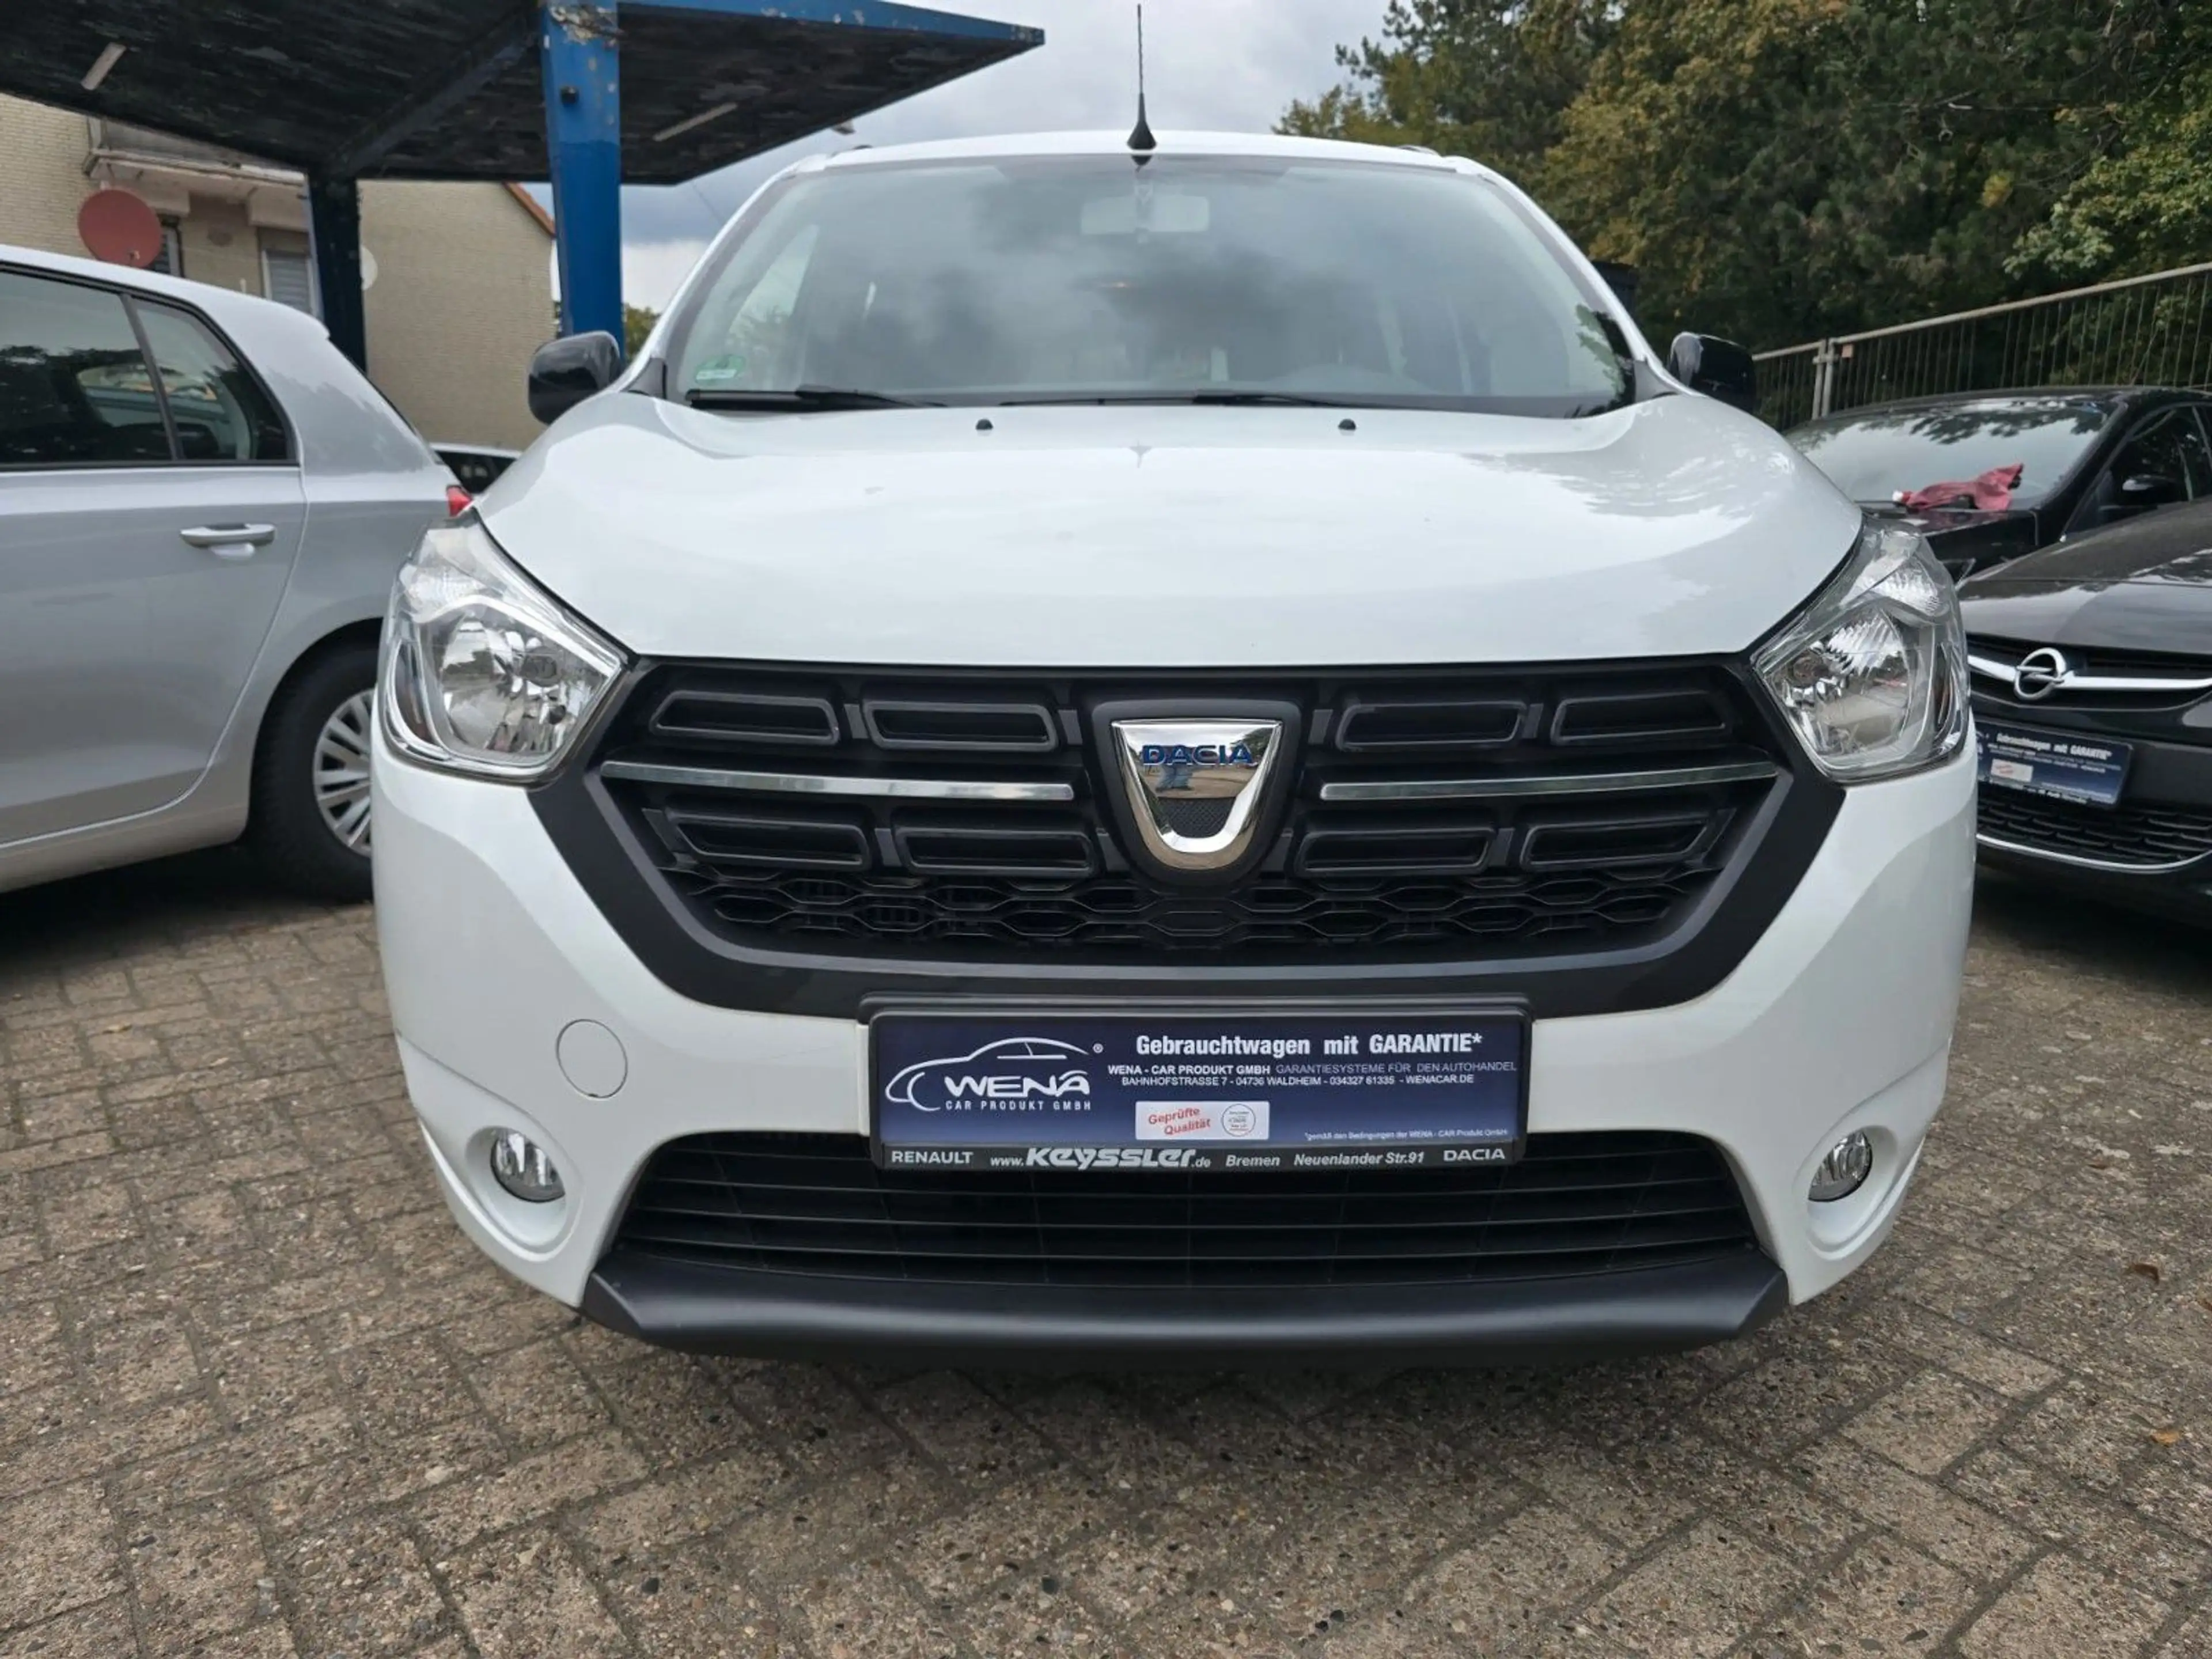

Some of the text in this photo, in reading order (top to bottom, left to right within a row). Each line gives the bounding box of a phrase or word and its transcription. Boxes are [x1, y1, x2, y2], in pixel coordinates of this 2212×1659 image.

[1142, 745, 1255, 765] DACIA
[1136, 1035, 1310, 1058] Gebrauchtwagen
[1324, 1036, 1359, 1054] mit
[1108, 1065, 1142, 1075] WENA
[1152, 1065, 1176, 1075] CAR
[1178, 1065, 1234, 1075] PRODUKT
[1236, 1065, 1271, 1075] GMBH
[1275, 1063, 1385, 1074] GARANTIESYSTEME
[1388, 1062, 1411, 1073] FÜR
[1416, 1063, 1440, 1073] DEN
[1441, 1062, 1517, 1072] AUTOHANDEL
[1122, 1076, 1219, 1086] BAHNHOFSTRASSE
[1221, 1077, 1228, 1086] 7
[1266, 1076, 1321, 1086] WALDHEIM
[1406, 1074, 1474, 1084] WENACAR.DE
[945, 1100, 1092, 1111] CAR PRODUKT GMBH
[1148, 1107, 1200, 1124] Geprüfte
[1164, 1118, 1211, 1135] Qualität
[892, 1150, 974, 1164] RENAULT
[1226, 1154, 1281, 1167] Bremen
[1294, 1153, 1381, 1166] Neuenlander
[1385, 1151, 1425, 1165] Str.91
[1444, 1148, 1506, 1161] DACIA
